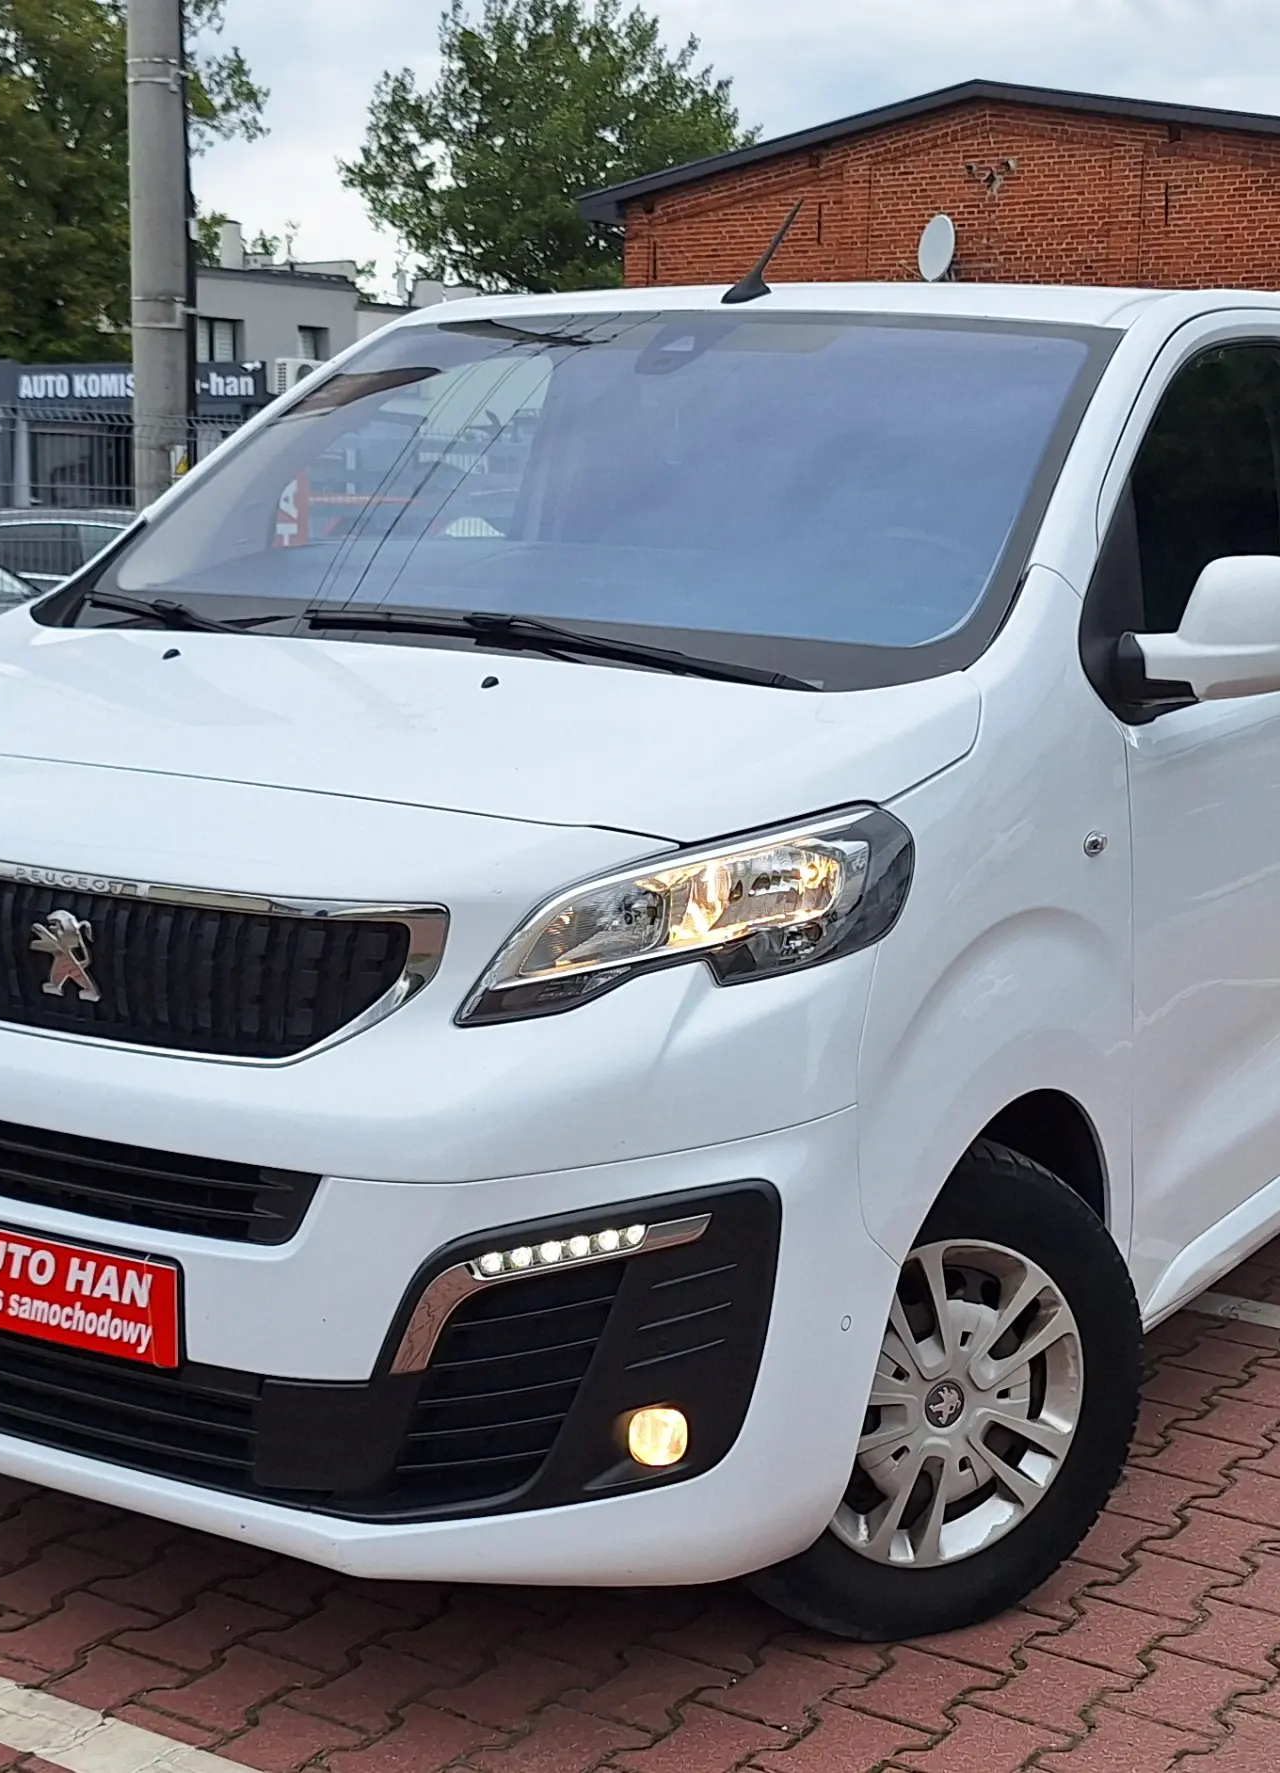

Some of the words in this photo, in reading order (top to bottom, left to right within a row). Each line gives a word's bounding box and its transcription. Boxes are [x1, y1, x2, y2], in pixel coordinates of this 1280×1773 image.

[19, 373, 69, 399] AUTO
[73, 372, 135, 398] KOMIS
[15, 866, 124, 895] PEUGEOT
[64, 1256, 154, 1309] HAN
[7, 1288, 154, 1354] samochodowy
